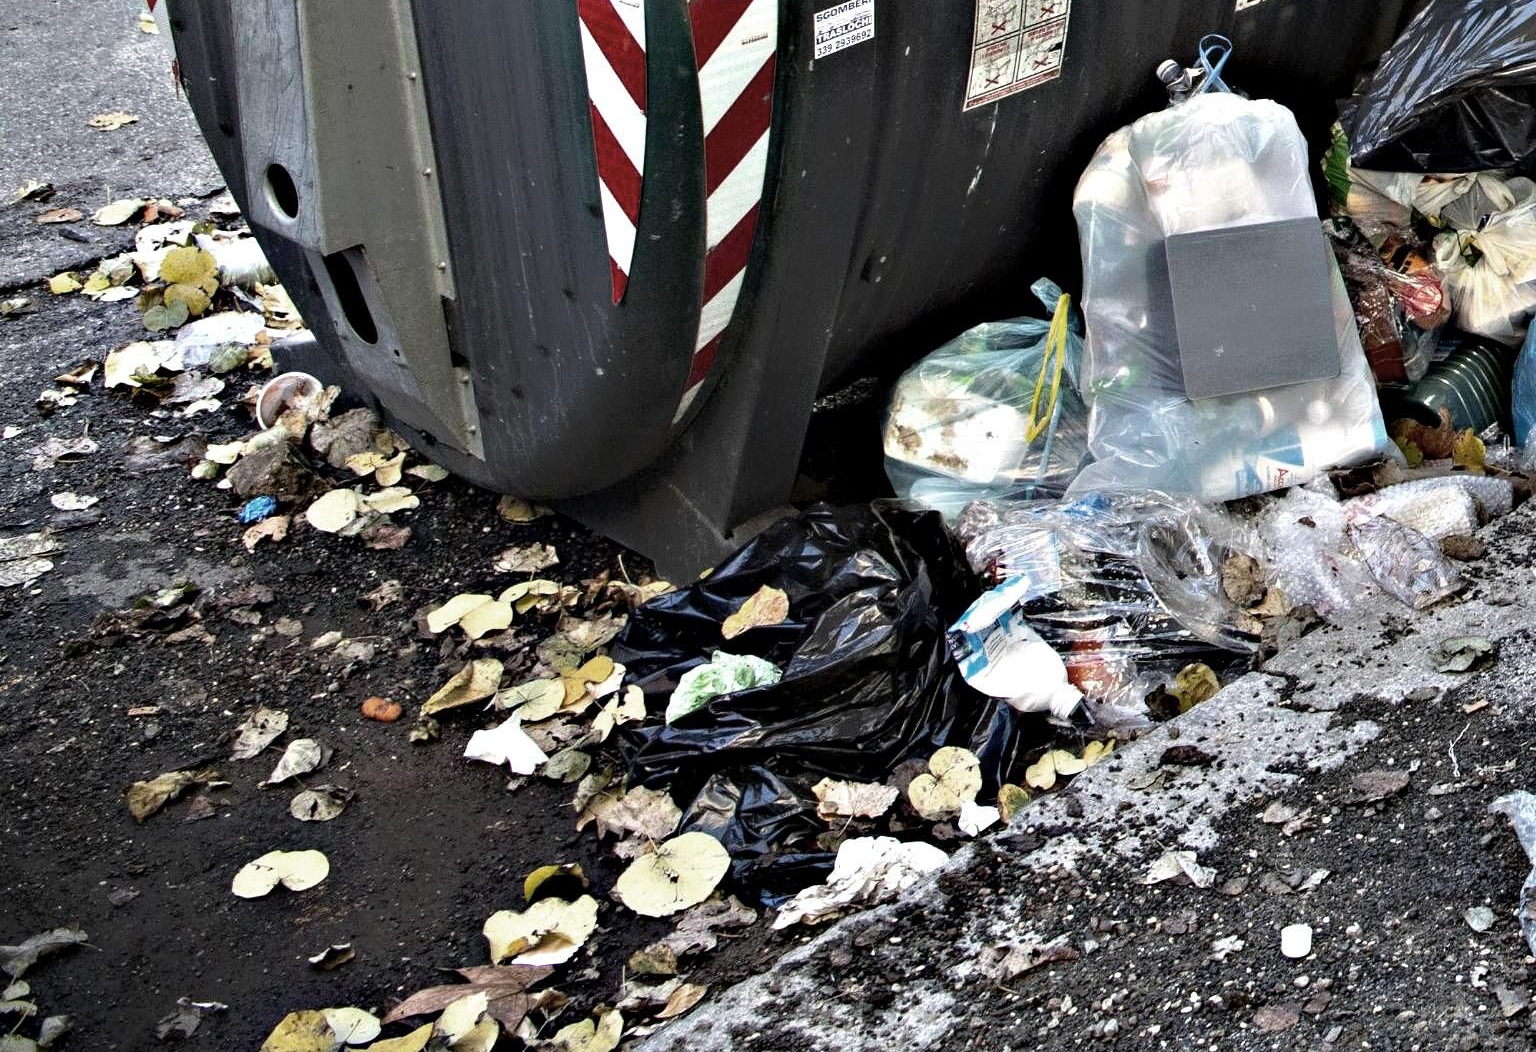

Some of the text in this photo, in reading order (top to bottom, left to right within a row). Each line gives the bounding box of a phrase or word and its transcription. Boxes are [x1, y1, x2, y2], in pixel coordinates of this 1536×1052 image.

[816, 15, 872, 45] TRASLOCHI
[817, 28, 872, 57] 339 2939692
